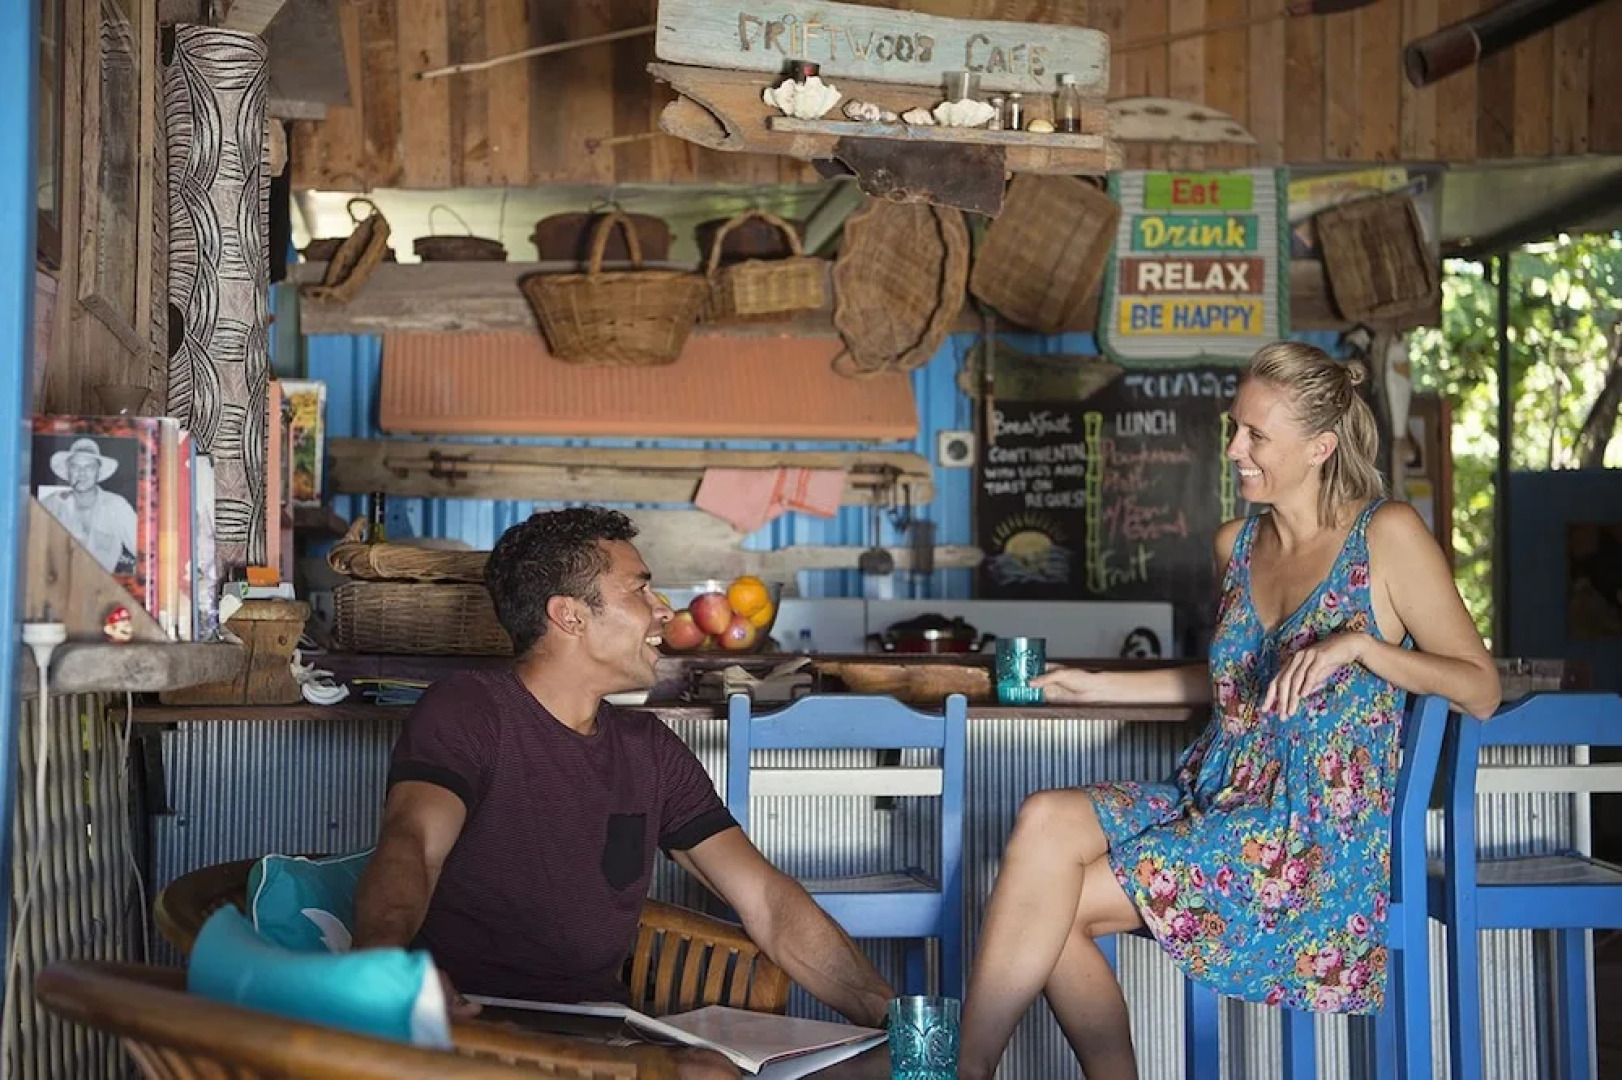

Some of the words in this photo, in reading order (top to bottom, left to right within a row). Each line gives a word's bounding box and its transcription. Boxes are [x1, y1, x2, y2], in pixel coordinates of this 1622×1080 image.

[1171, 179, 1221, 204] Eat
[1141, 217, 1246, 248] Drink
[1138, 263, 1249, 290] RELAX
[1131, 304, 1162, 330] BE
[1173, 305, 1253, 330] HAPPY
[1115, 410, 1177, 436] LUNCH
